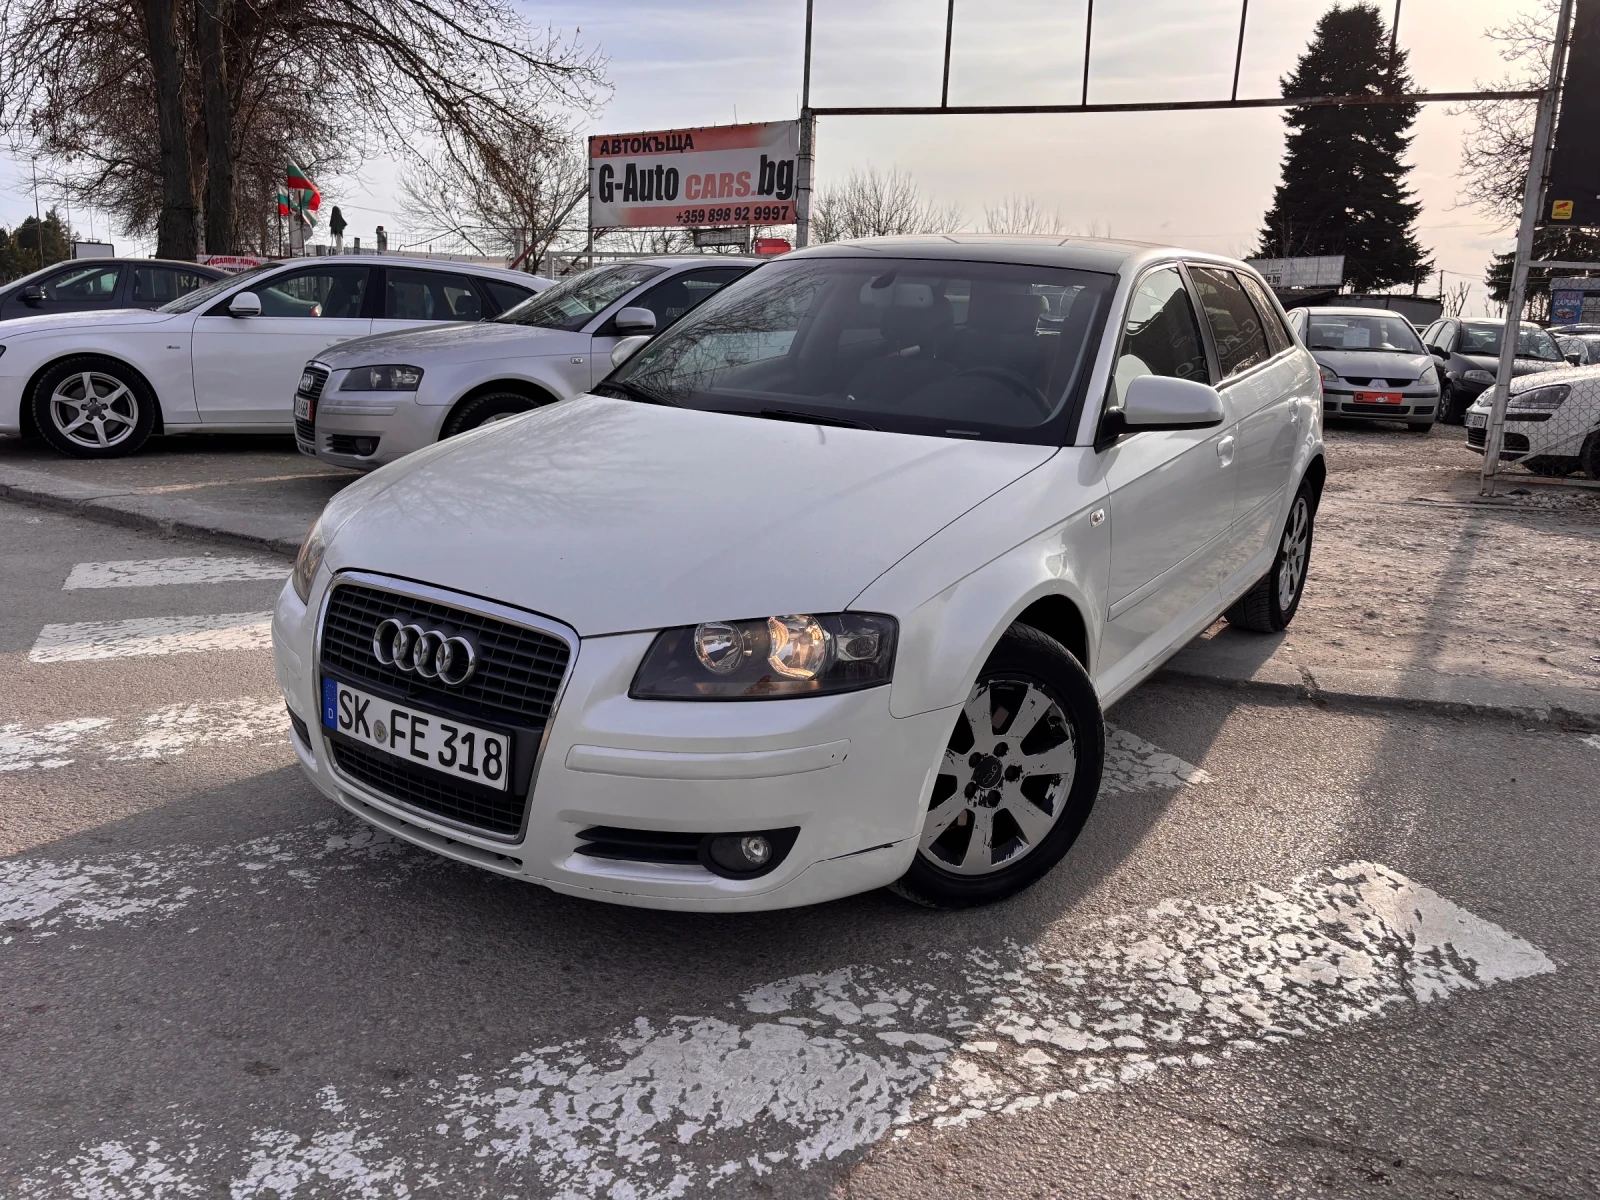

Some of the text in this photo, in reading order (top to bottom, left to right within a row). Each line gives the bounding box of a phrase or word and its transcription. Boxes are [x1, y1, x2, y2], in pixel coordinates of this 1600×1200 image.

[600, 133, 694, 155] АВТОКЪЩА
[599, 154, 794, 203] G-Auto CARS.bg
[676, 205, 789, 224] +359 898 92 9997
[328, 707, 334, 720] D
[338, 689, 502, 781] SK FE 318
